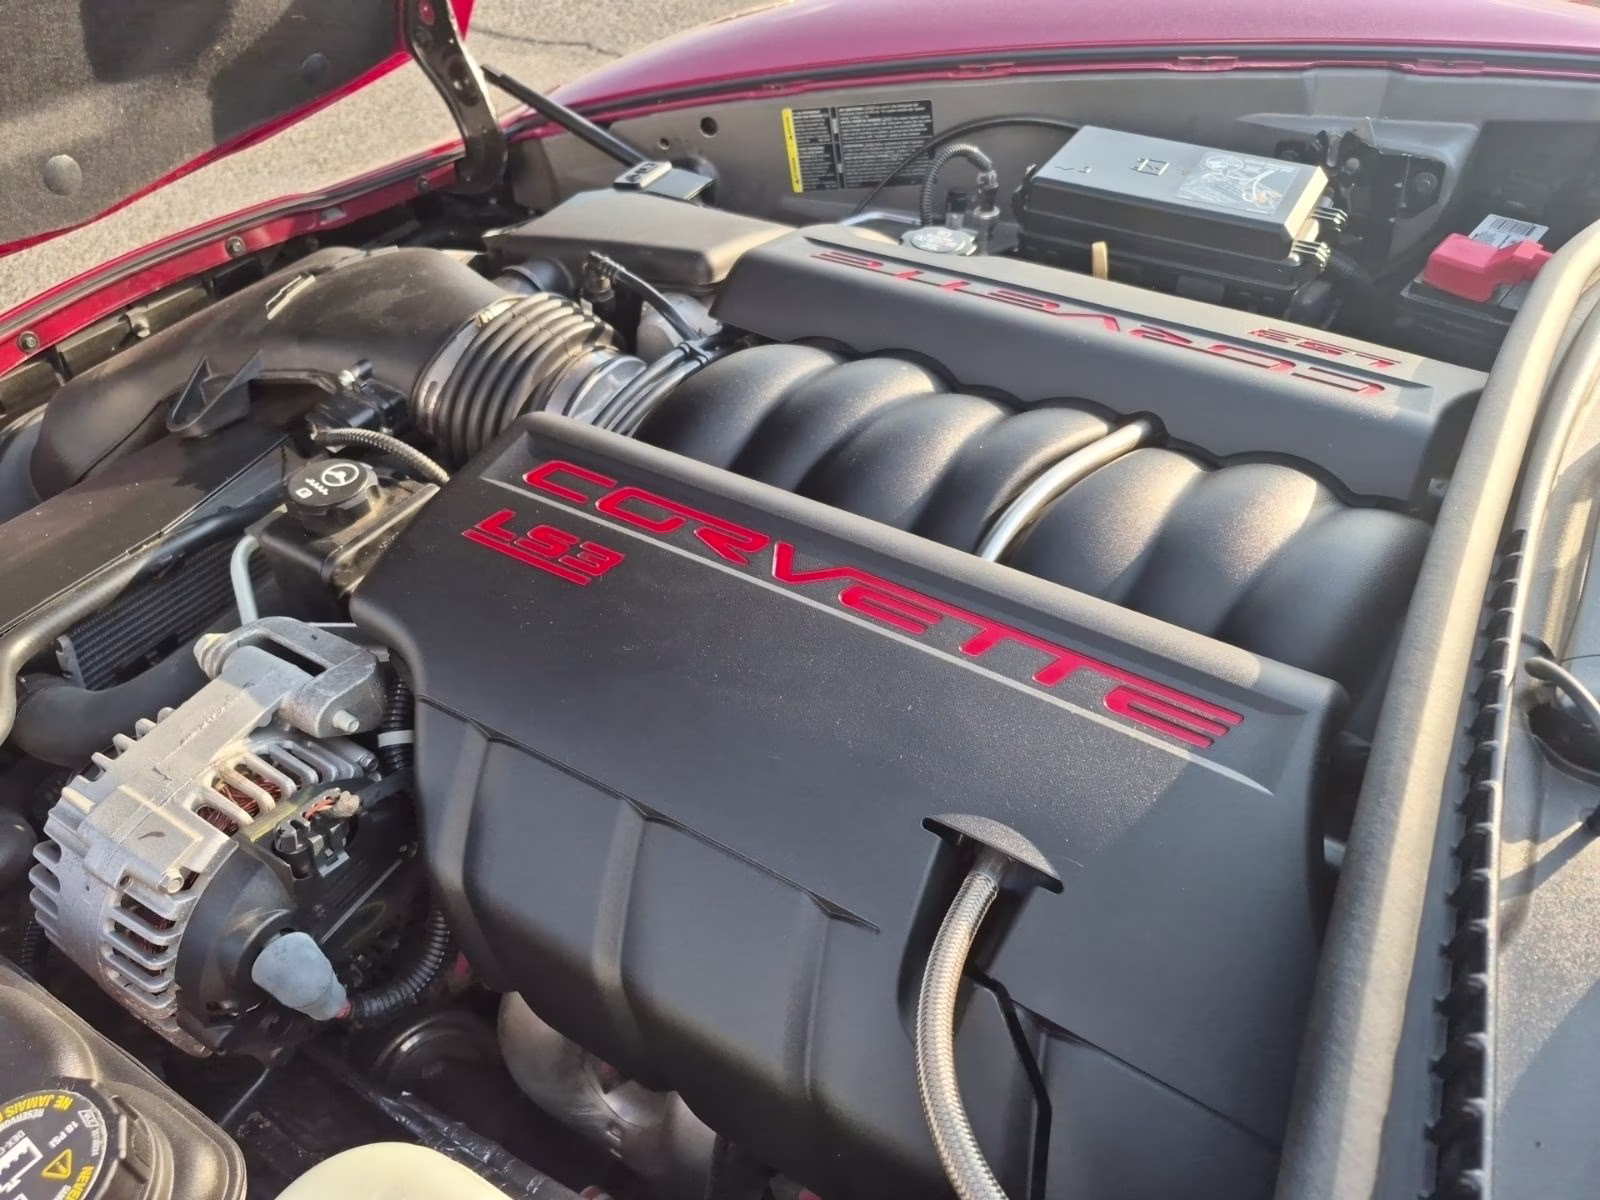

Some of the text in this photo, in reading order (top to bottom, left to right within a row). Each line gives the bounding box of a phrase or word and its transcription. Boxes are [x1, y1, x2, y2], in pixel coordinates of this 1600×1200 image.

[810, 251, 1386, 394] CORVETTE
[462, 508, 626, 586] LS3
[522, 459, 1245, 749] CORVETTE
[5, 1094, 55, 1118] JAMAIS
[53, 1094, 74, 1111] NE
[48, 1120, 79, 1149] 18 PSI
